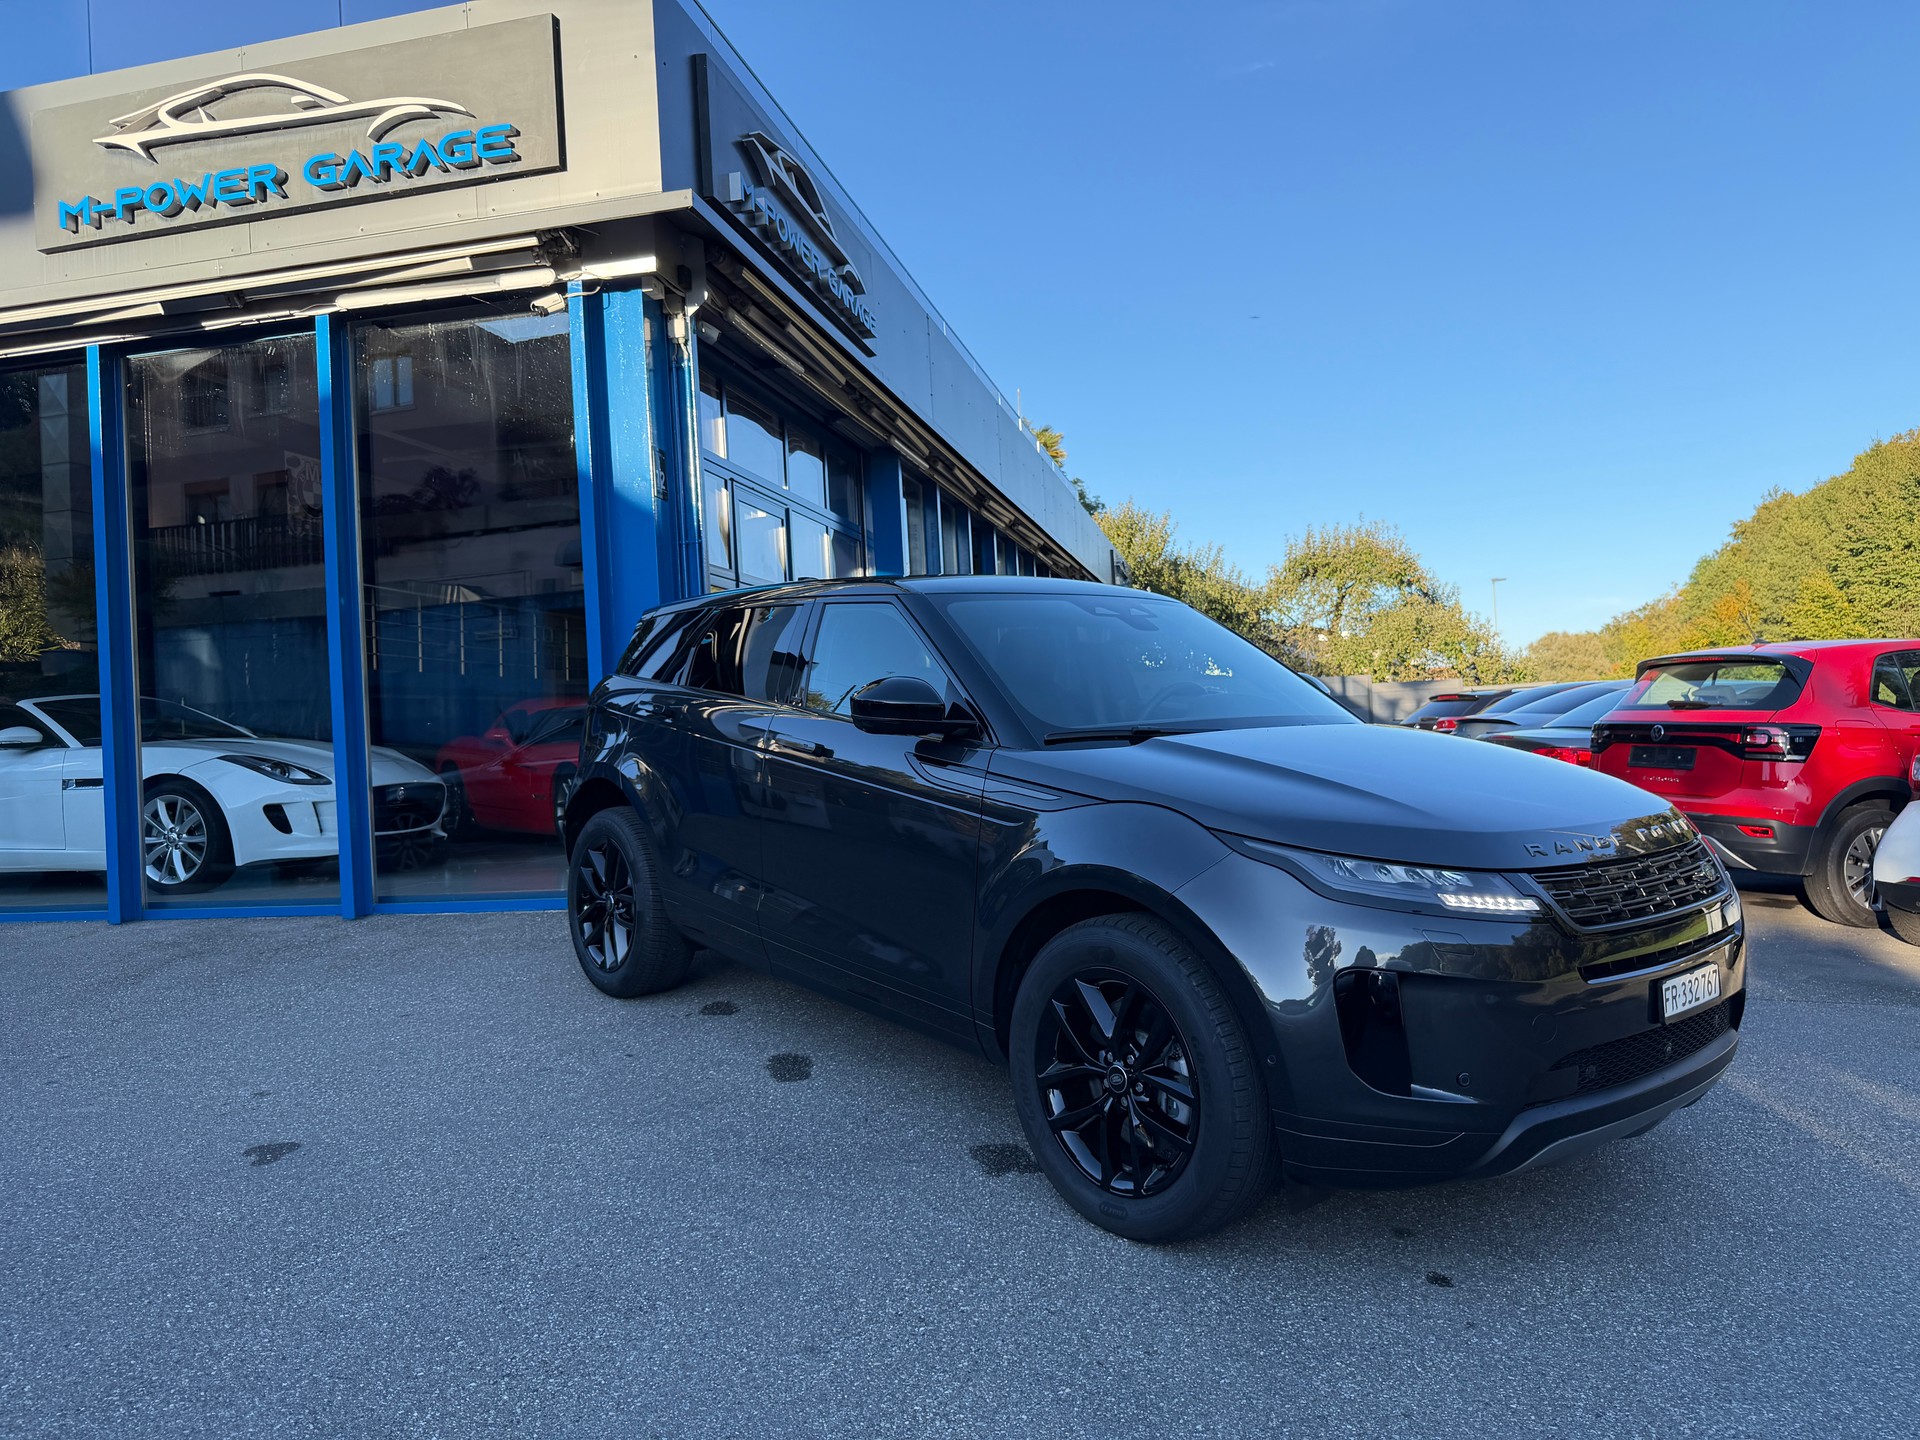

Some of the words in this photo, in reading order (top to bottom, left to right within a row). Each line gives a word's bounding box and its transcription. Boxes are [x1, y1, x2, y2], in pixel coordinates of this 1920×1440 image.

[59, 163, 283, 231] M-POWER
[303, 123, 517, 189] GARAGE
[737, 174, 823, 281] M-POWER
[827, 268, 878, 335] GARAGE
[1523, 832, 1623, 858] RANGE
